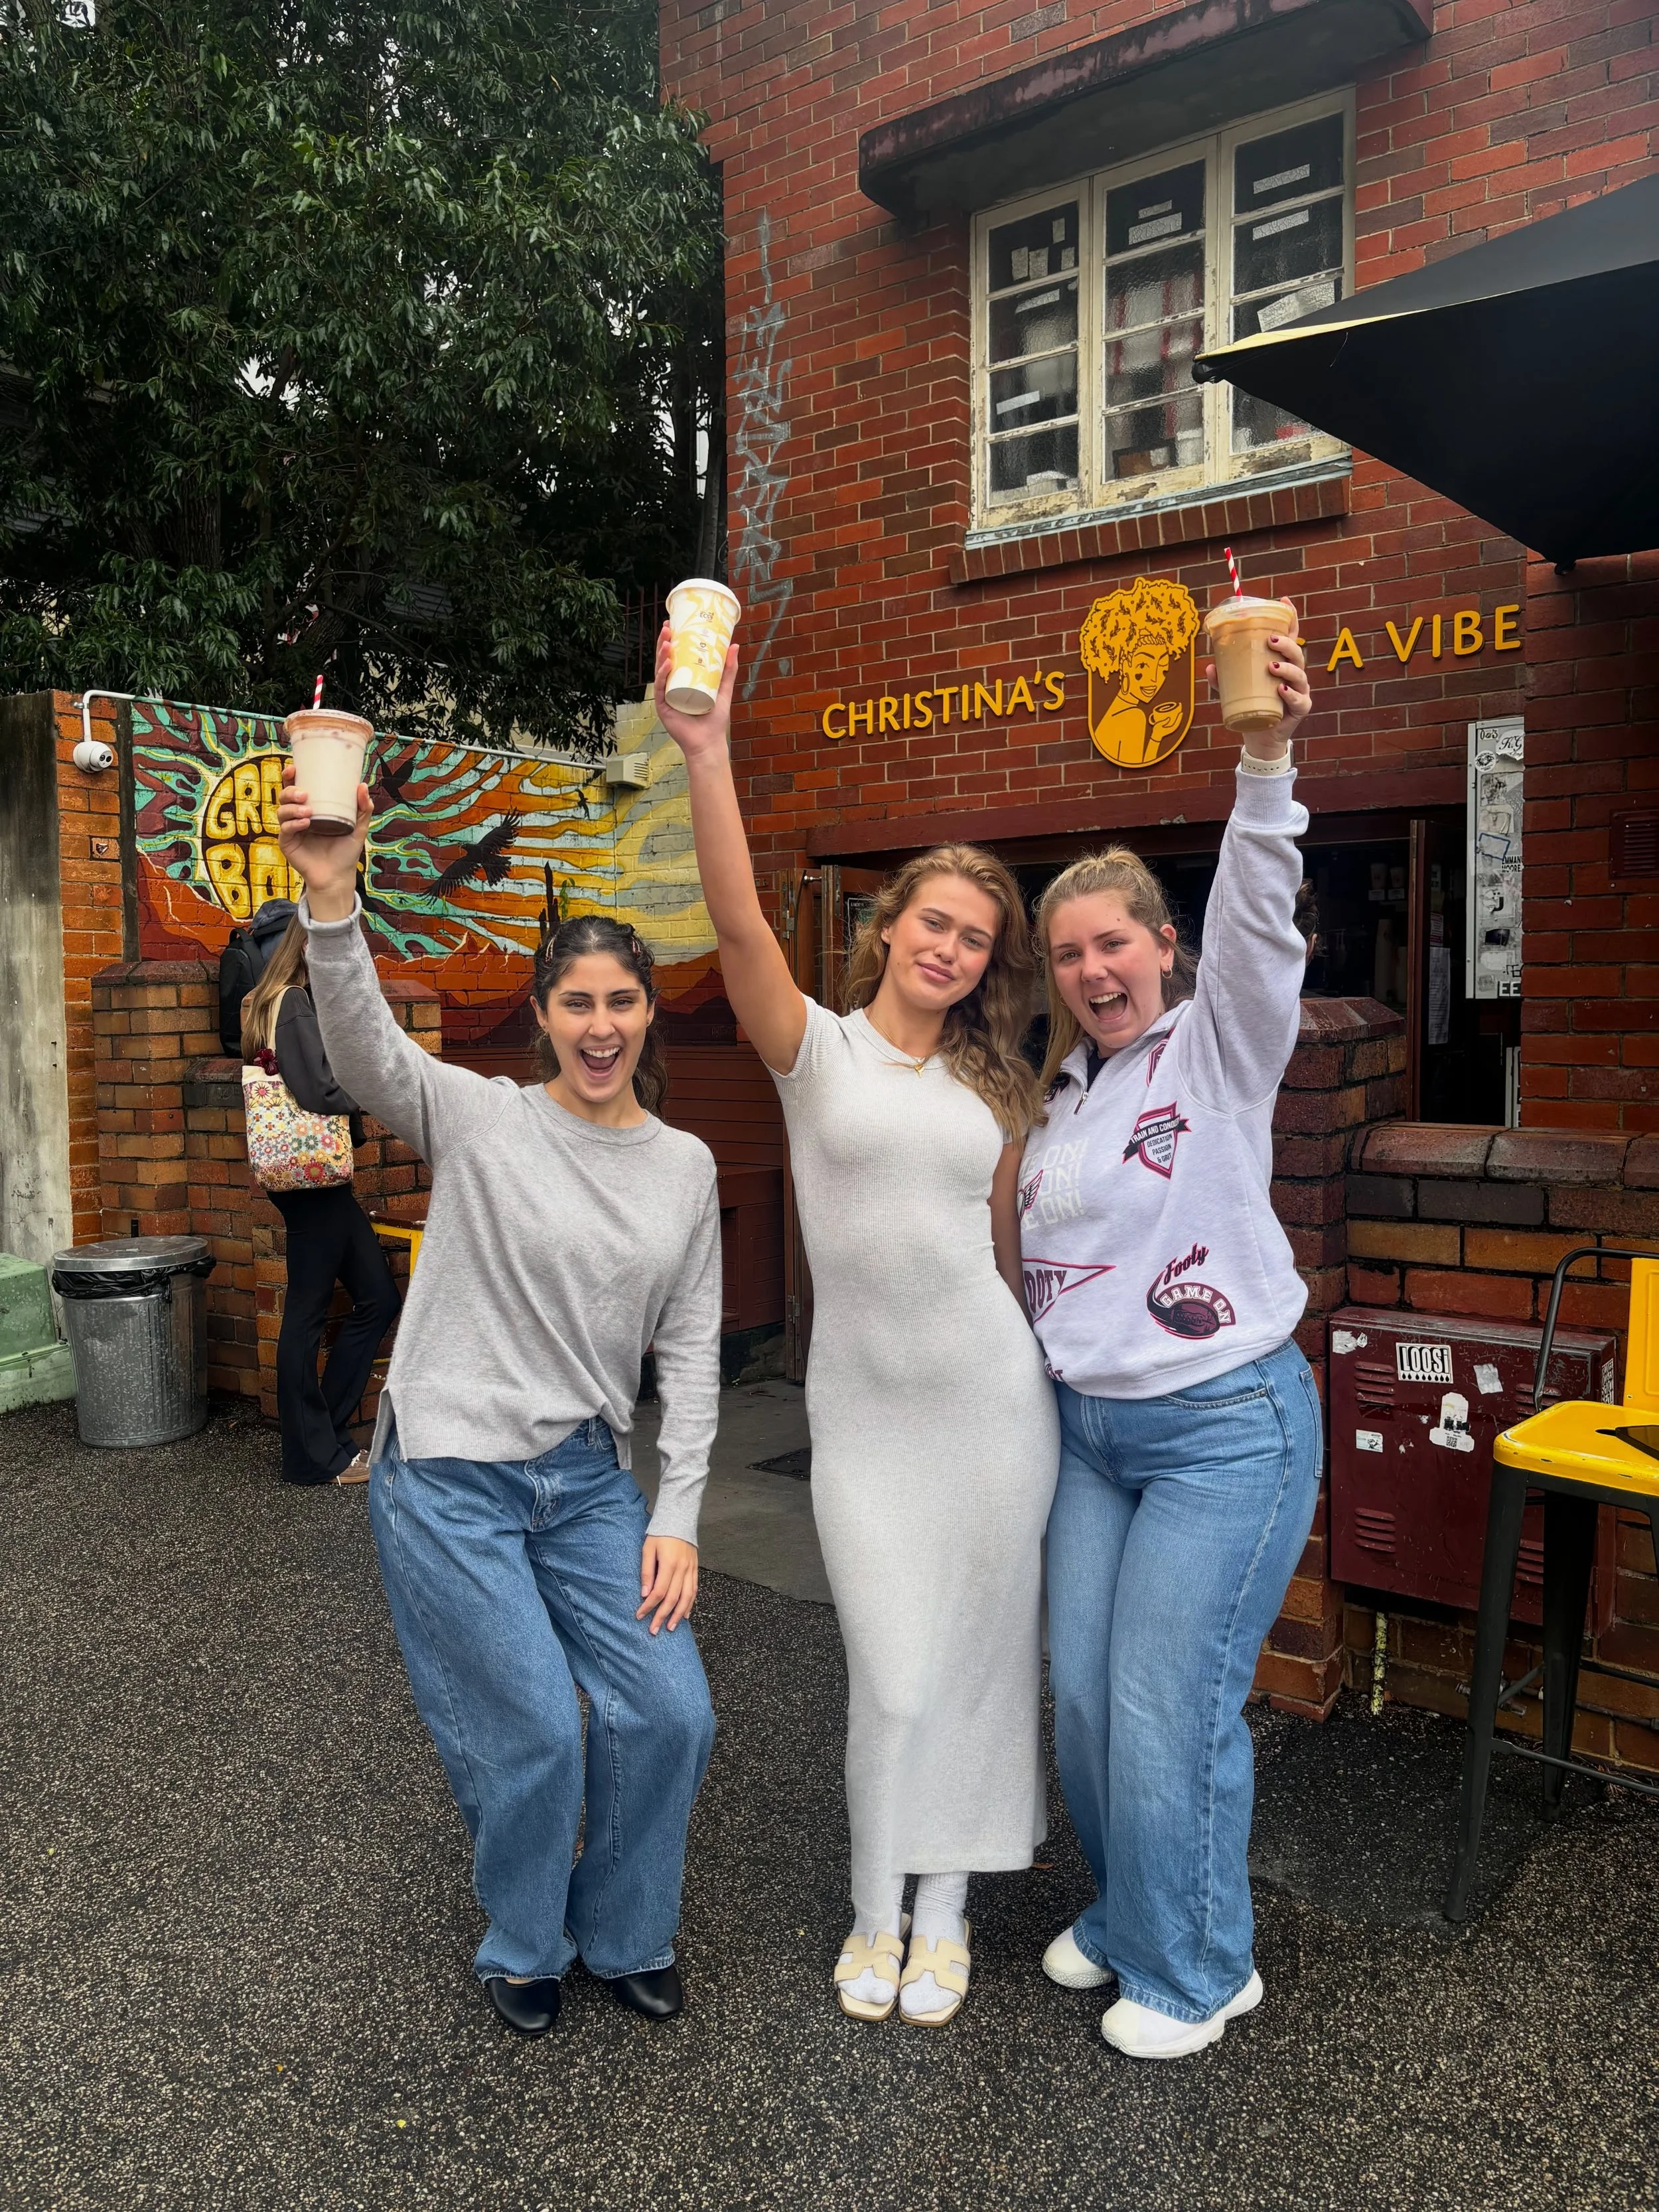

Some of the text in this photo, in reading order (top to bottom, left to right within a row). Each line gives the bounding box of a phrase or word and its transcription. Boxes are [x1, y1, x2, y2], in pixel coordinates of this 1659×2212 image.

[1327, 603, 1522, 672] A VIBE
[822, 670, 1065, 739] CHRISTINA'S
[1131, 1130, 1147, 1143] TRAIN
[1148, 1126, 1159, 1136] AND
[1147, 1133, 1172, 1147] DEDICATION
[1152, 1143, 1171, 1155] PASSION
[1162, 1153, 1172, 1161] GRIT
[1163, 1242, 1210, 1286] Footy
[1160, 1285, 1213, 1309] GAME
[1212, 1298, 1232, 1323] ON
